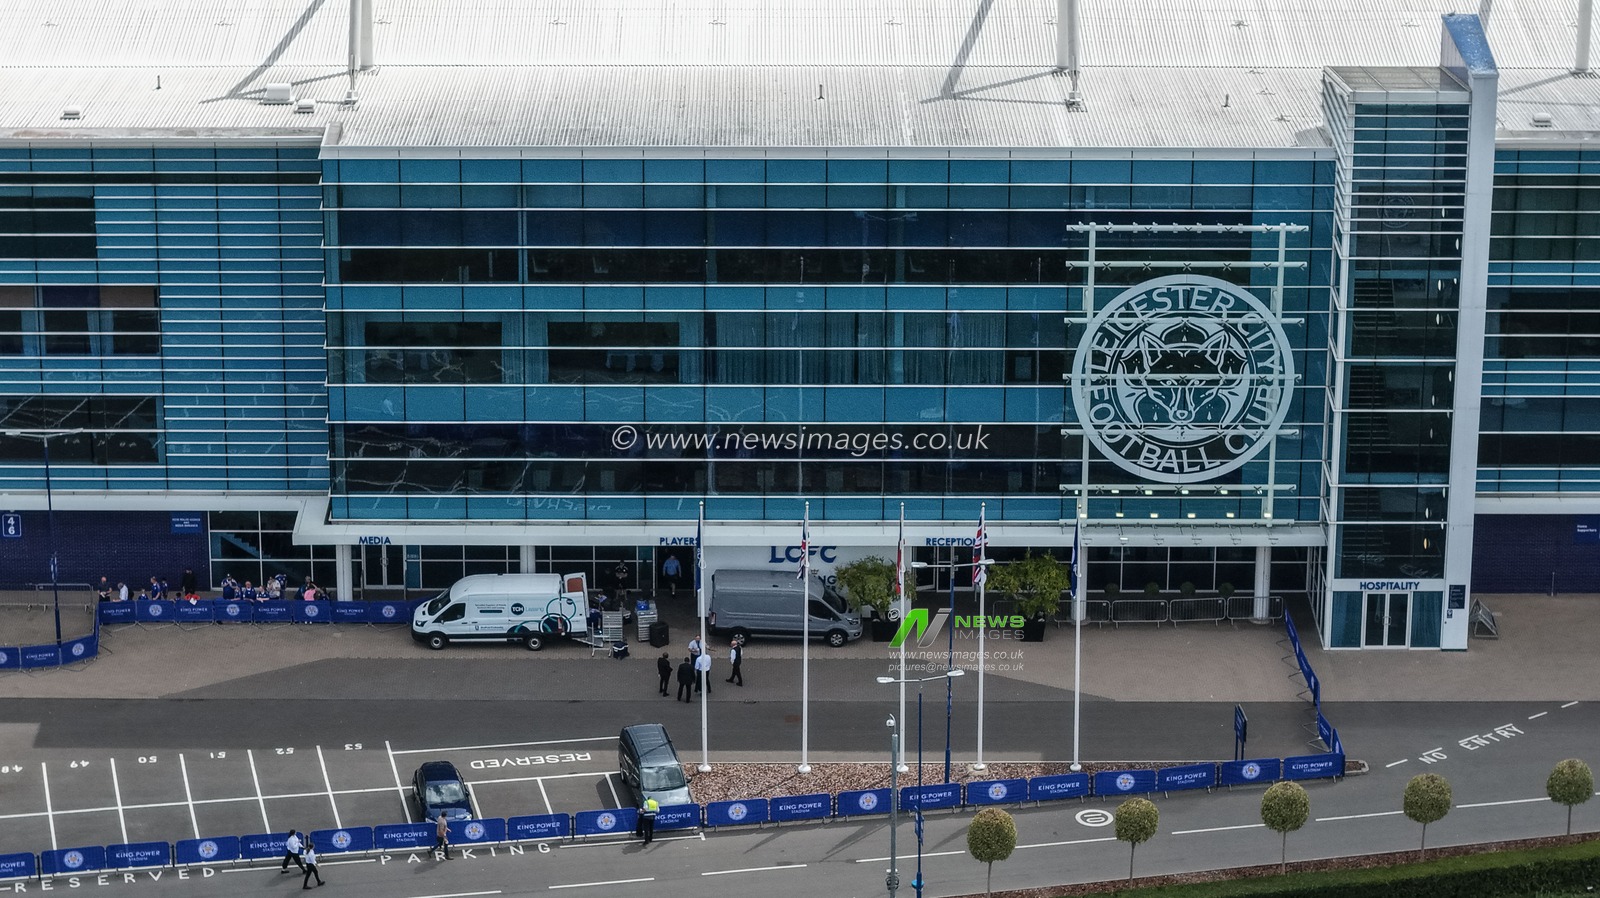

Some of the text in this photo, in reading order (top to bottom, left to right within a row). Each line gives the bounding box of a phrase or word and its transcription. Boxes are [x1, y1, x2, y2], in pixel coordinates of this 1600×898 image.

[1085, 286, 1283, 373] LEICESTER CITY
[1082, 383, 1282, 473] FOOTBALL CLUB
[7, 517, 15, 525] 4
[8, 526, 16, 535] 6
[359, 536, 391, 545] MEDIA
[769, 546, 837, 563] LCFC
[1360, 582, 1420, 591] HOSPITALITY
[1459, 725, 1524, 750] ENTRY
[275, 747, 294, 755] 52
[138, 756, 157, 764] 50
[470, 752, 591, 769] RESERVED
[1419, 752, 1447, 764] NO
[70, 759, 89, 768] 49
[1, 764, 23, 773] 48
[928, 791, 952, 799] POWER
[15, 842, 551, 893] RESERVED PARKING
